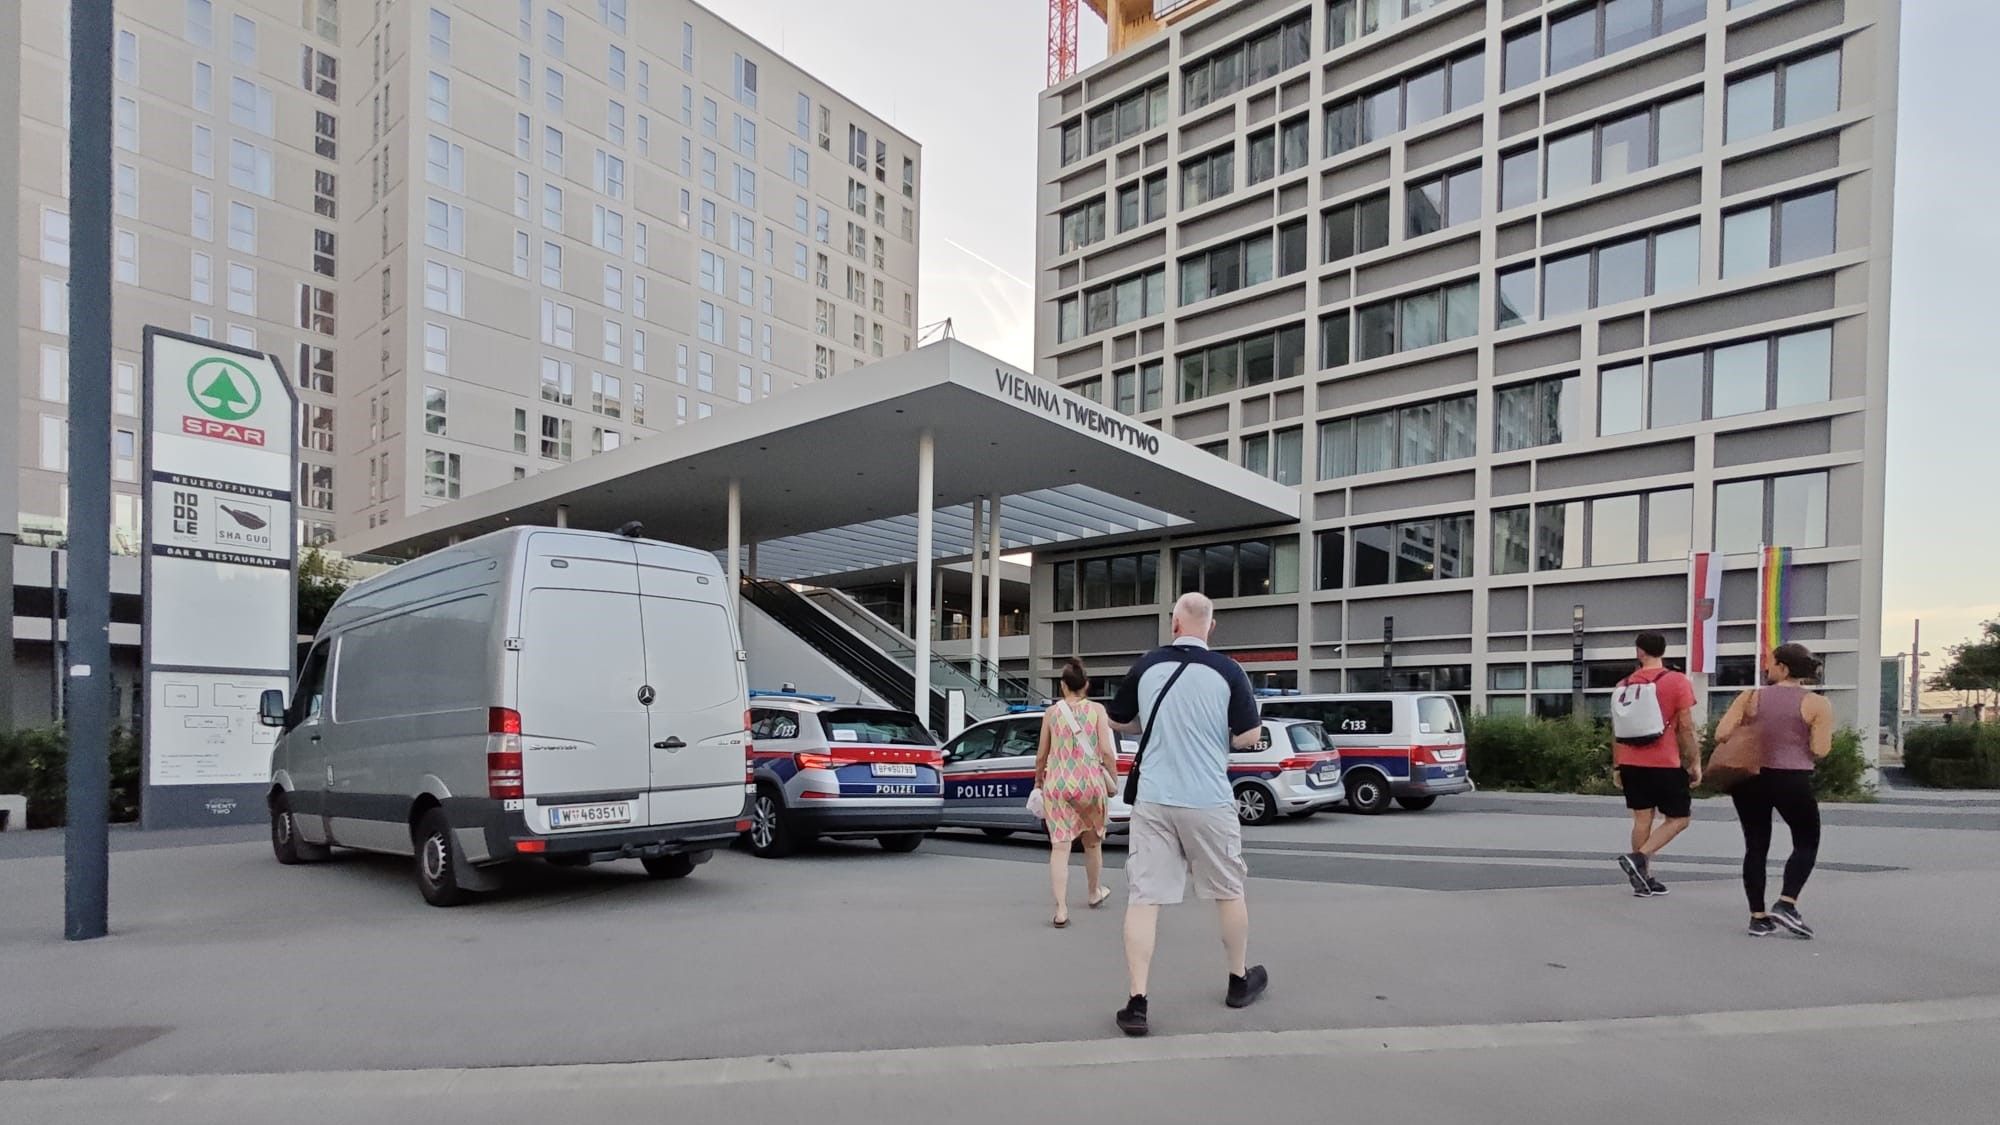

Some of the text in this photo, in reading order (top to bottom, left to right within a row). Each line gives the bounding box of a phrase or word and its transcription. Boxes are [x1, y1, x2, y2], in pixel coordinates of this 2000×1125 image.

[995, 368, 1159, 455] VIENNA TWENTYTWO
[186, 418, 264, 444] SPAR
[172, 475, 273, 498] NEUERÖFFNUNG
[219, 530, 241, 540] SHA
[167, 547, 277, 566] BAR & RESTAURANT
[781, 725, 797, 736] 133
[1350, 720, 1367, 730] 133
[1253, 741, 1268, 750] 133
[876, 784, 916, 793] POLIZEI
[957, 784, 1009, 798] POLIZEI
